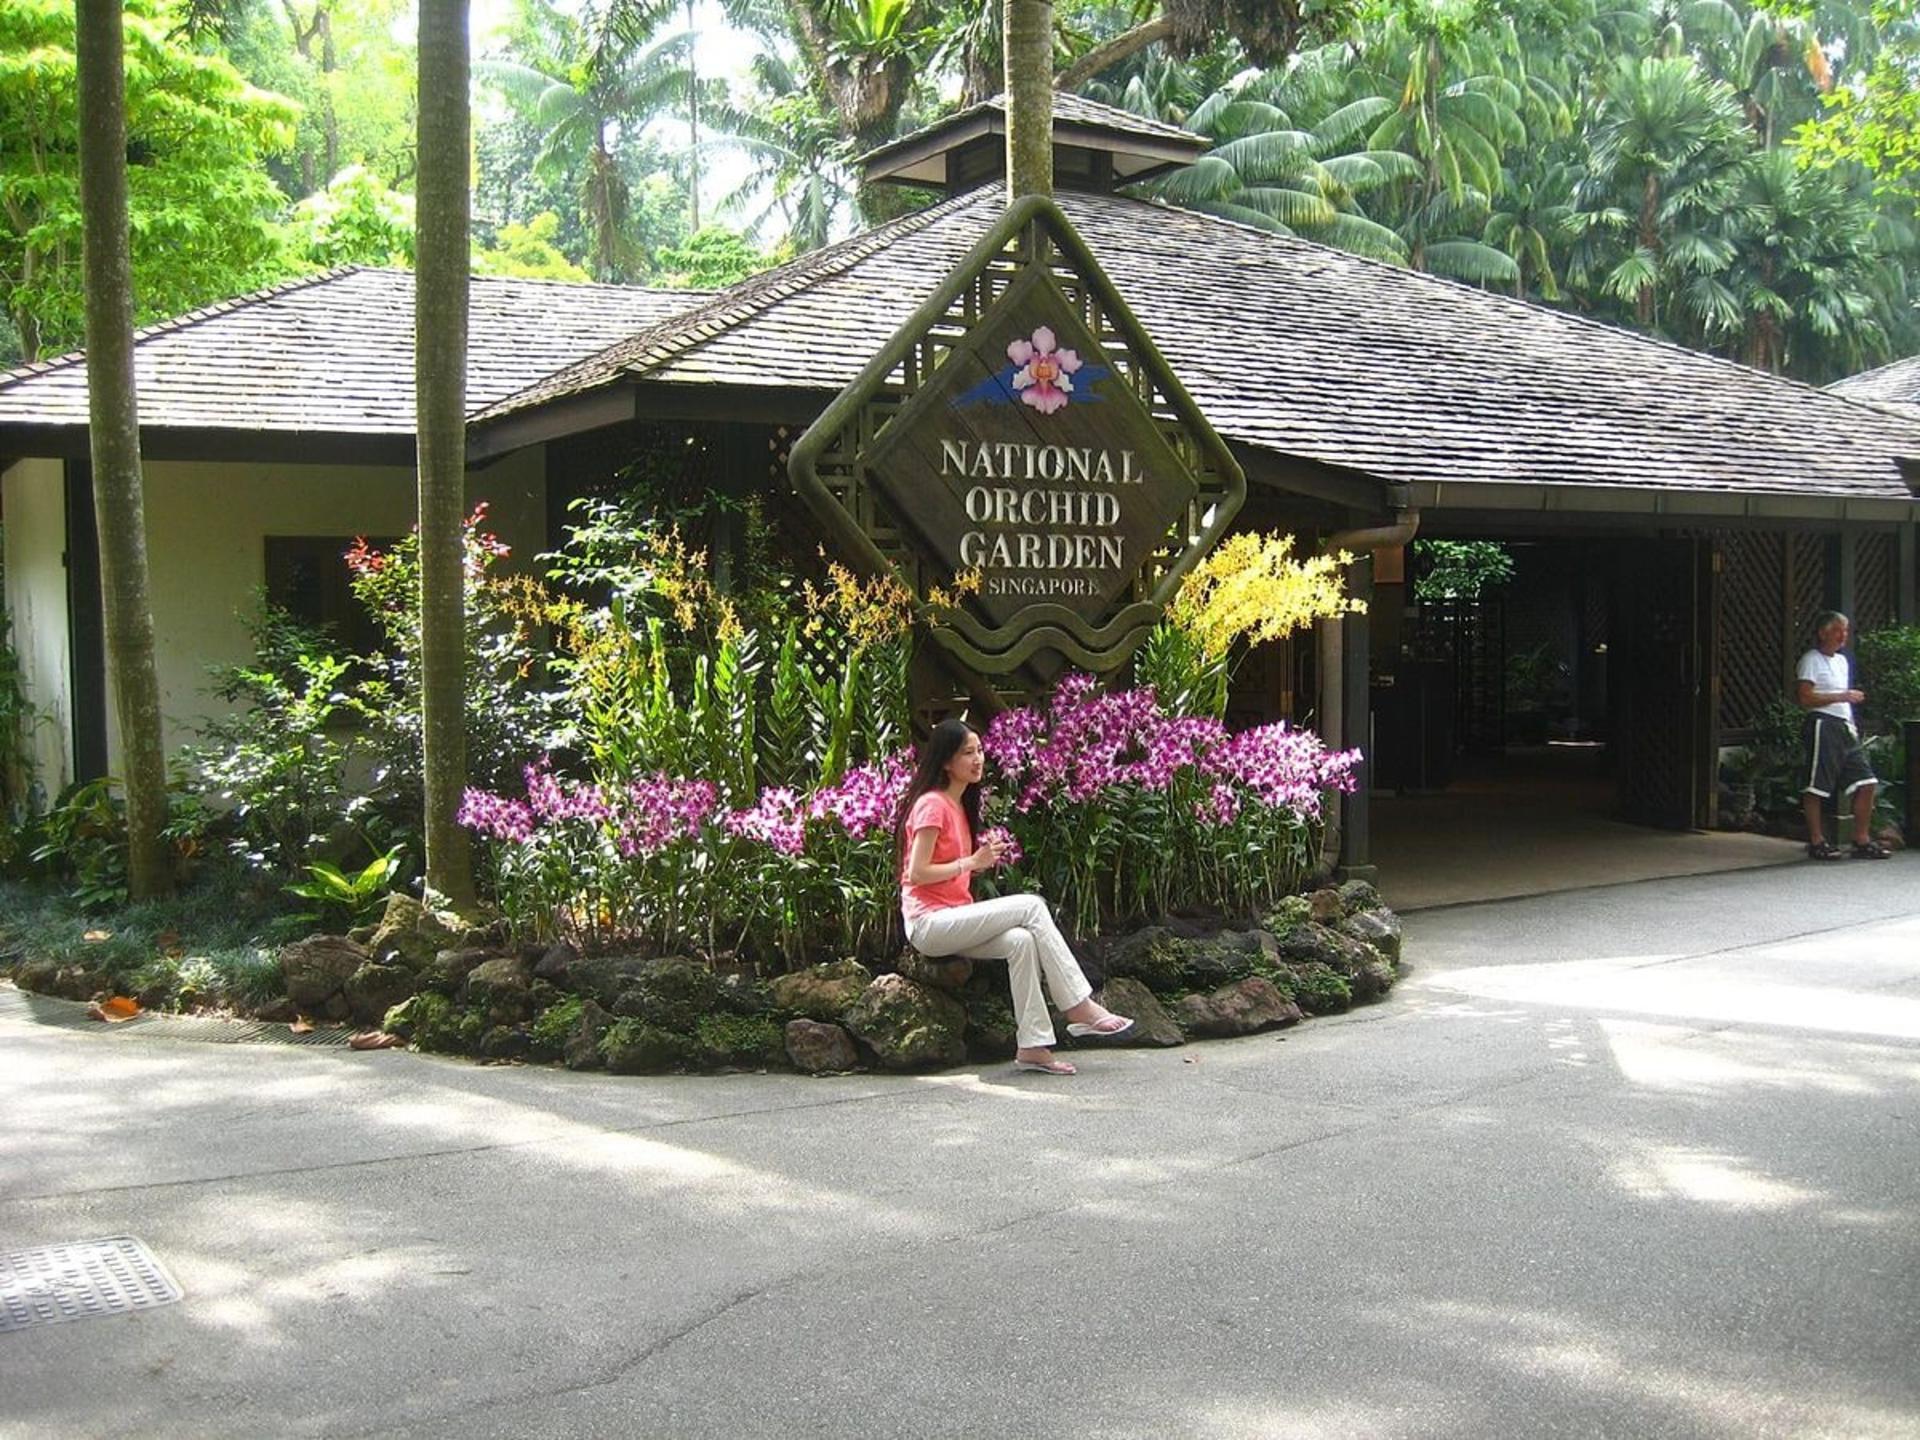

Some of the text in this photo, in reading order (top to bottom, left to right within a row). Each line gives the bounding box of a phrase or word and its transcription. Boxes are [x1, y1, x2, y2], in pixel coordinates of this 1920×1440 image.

[940, 439, 1143, 484] NATIONAL
[965, 486, 1120, 526] ORCHID
[959, 531, 1125, 569] GARDEN
